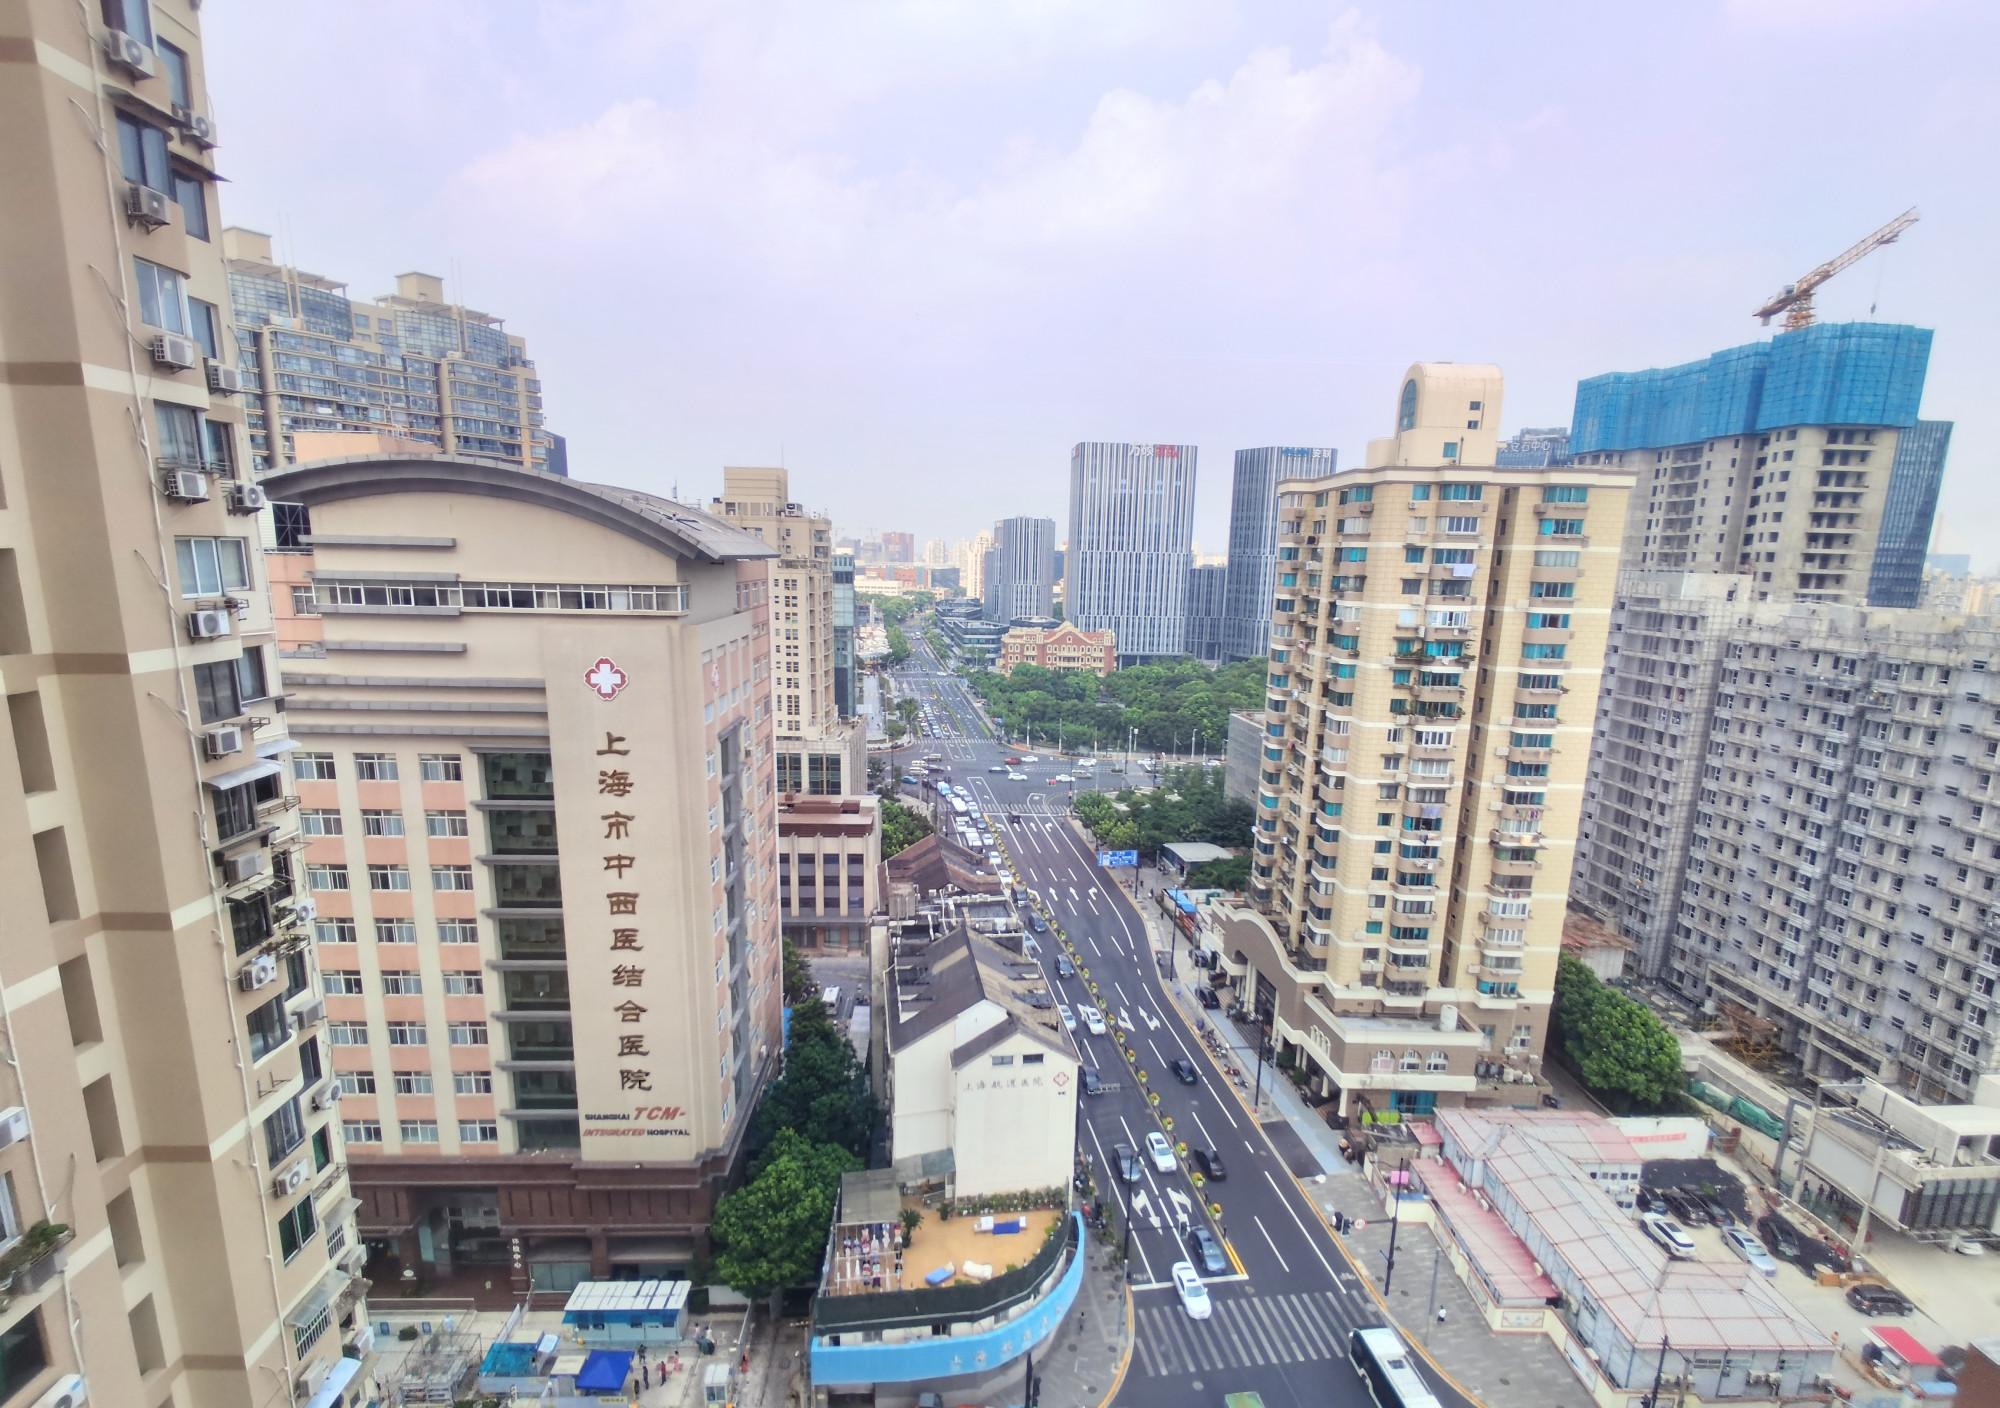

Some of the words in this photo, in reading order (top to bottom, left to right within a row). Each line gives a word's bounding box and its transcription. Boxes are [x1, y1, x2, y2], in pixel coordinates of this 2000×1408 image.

[595, 731, 653, 1092] 上海市中西医结合医院
[646, 1128, 690, 1136] HOSPITAL
